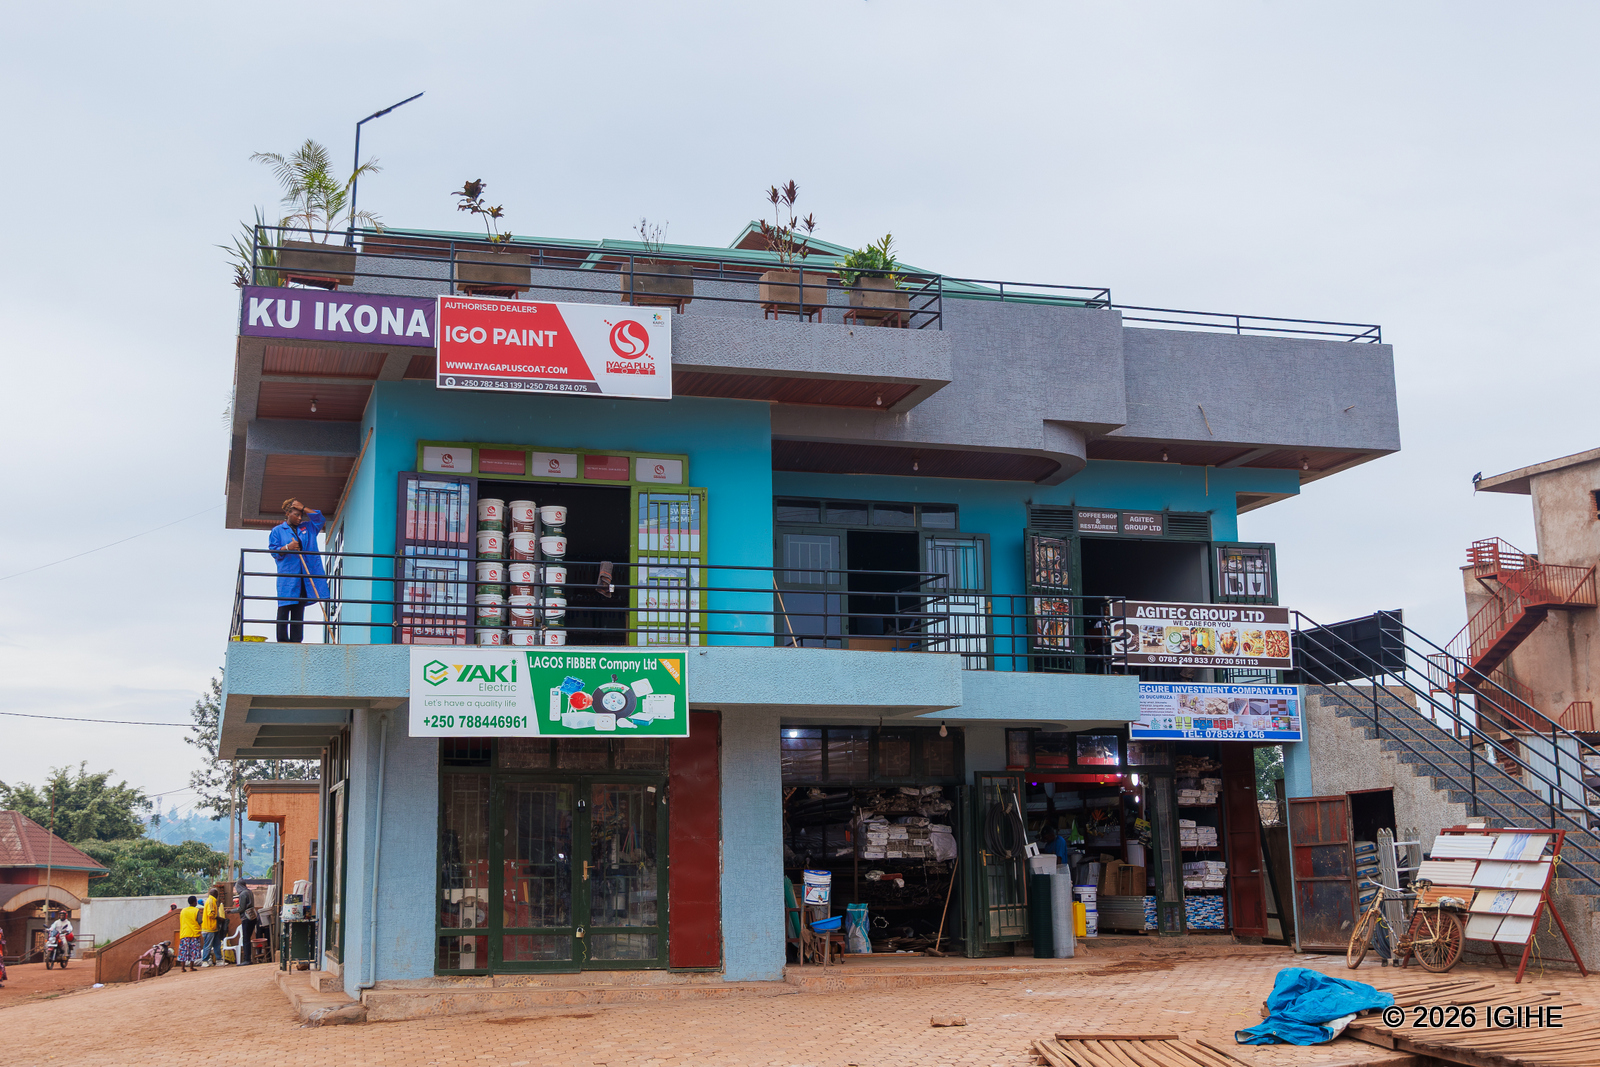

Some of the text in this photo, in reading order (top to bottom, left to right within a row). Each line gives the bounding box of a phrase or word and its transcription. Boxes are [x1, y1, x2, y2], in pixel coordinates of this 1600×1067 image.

[444, 301, 538, 314] AUTHORISED DEALERS
[248, 297, 431, 338] KU IKONA
[445, 325, 558, 348] IGO PAINT
[445, 361, 568, 375] WWW.IYAGAPLUSCOAT.COM
[480, 380, 493, 388] 782
[495, 381, 509, 389] 543
[560, 383, 572, 391] 874
[1135, 606, 1265, 622] AGITEC GROUP LTD
[529, 656, 657, 673] LAGOS FIBBER Compny Ltd
[478, 682, 517, 692] Electric
[1172, 685, 1229, 694] INVESTMENT
[1231, 687, 1274, 695] COMPANY
[1276, 687, 1293, 695] LTD
[424, 699, 442, 707] Let's
[444, 699, 465, 707] have
[474, 699, 503, 709] quality
[504, 699, 517, 707] life
[423, 715, 527, 729] +250 788446961
[1181, 730, 1265, 739] TEL: 0785373 046
